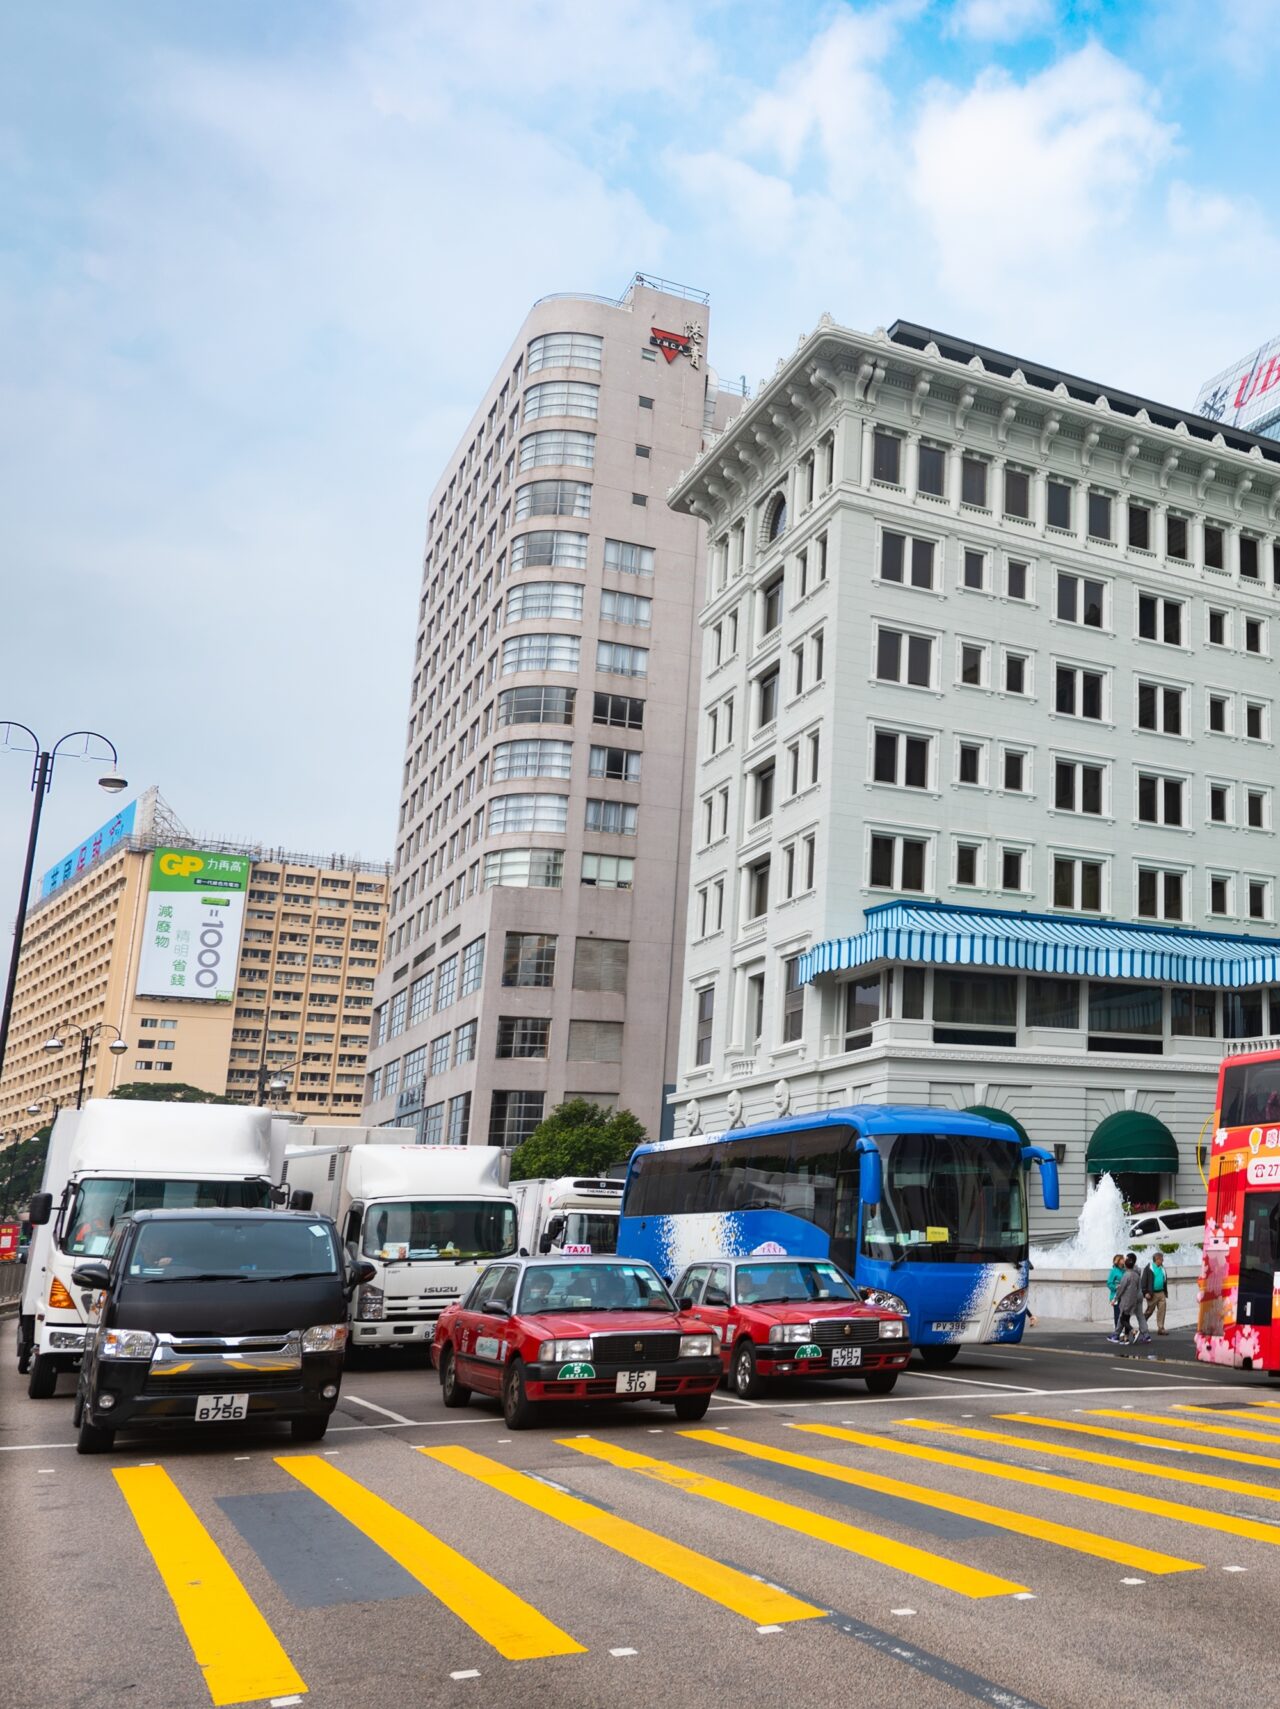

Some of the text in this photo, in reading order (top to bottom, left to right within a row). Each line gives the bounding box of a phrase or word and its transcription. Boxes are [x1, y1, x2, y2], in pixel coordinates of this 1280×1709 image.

[656, 338, 684, 351] YMCA
[160, 853, 204, 877] GP
[155, 905, 173, 948] 減廢物
[170, 930, 190, 986] 精明省錢
[936, 1322, 966, 1330] PV 396
[833, 1356, 860, 1366] 5727
[573, 1366, 582, 1374] 5
[629, 1371, 645, 1382] EF
[625, 1381, 647, 1392] 319
[213, 1396, 234, 1408] TJ
[199, 1406, 243, 1420] 8756
